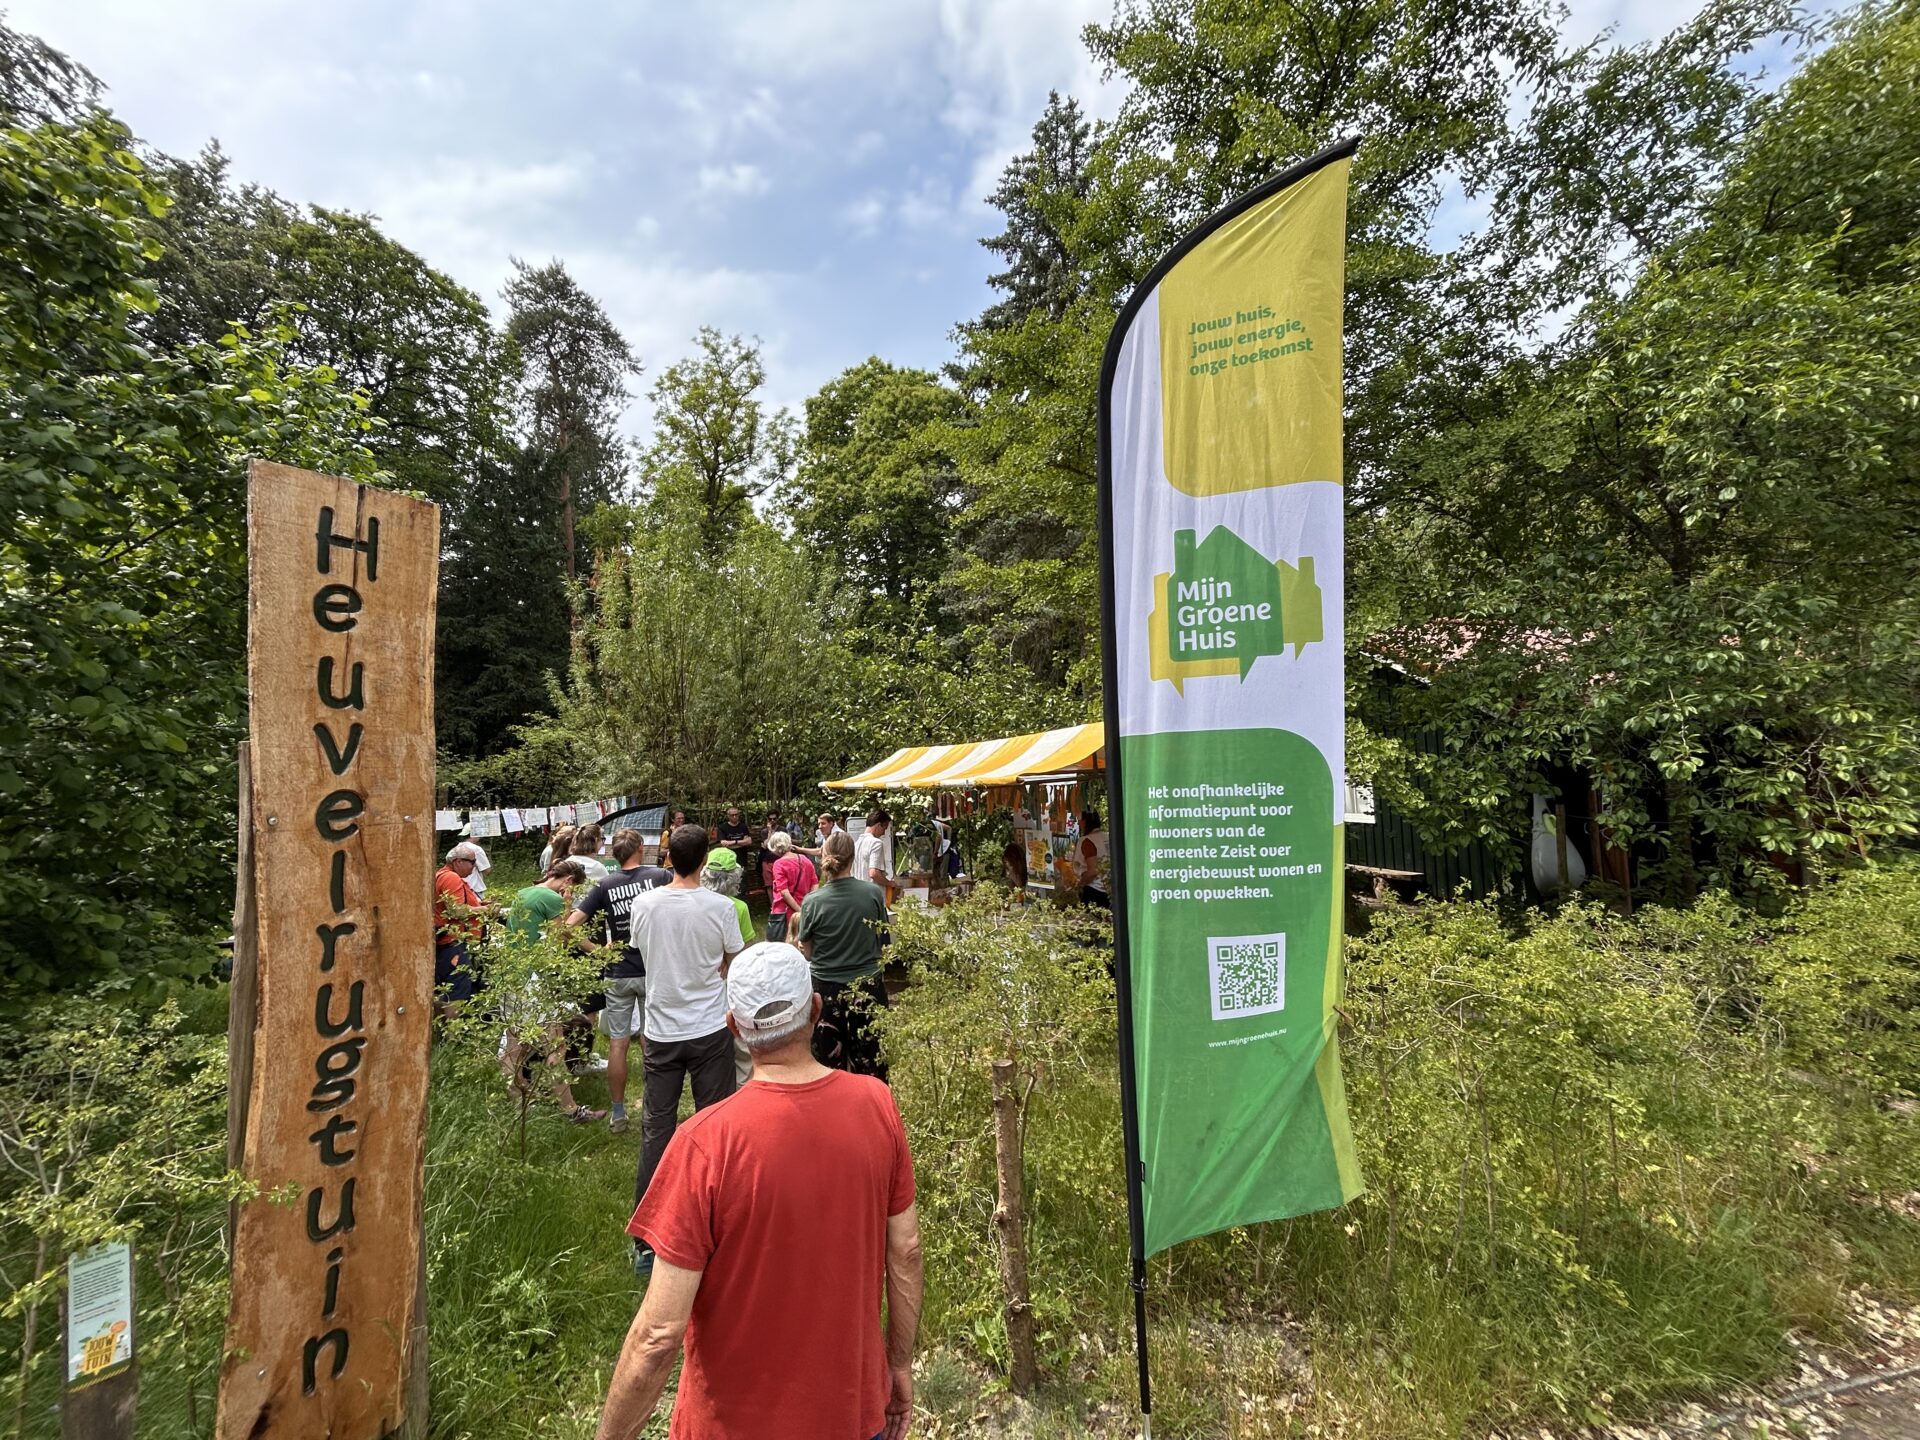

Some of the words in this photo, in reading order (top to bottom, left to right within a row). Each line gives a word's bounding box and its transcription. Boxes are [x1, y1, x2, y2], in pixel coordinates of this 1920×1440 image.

[1188, 316, 1233, 335] Jouw
[1236, 305, 1276, 324] huis,
[1191, 337, 1233, 358] jouw
[1237, 319, 1306, 345] energie,
[1189, 359, 1228, 376] onze
[1231, 338, 1314, 367] toekomst
[1177, 577, 1232, 606] Mijn
[1177, 602, 1272, 627] Groene
[1178, 625, 1237, 652] Huis
[1148, 785, 1169, 799] Het
[1172, 782, 1285, 801] onafhankelijke
[1148, 803, 1257, 822] informatiepunt
[1260, 804, 1294, 817] voor
[1149, 825, 1213, 839] inwoners
[1216, 826, 1244, 838] van
[1247, 824, 1266, 837] de
[1149, 845, 1218, 863] gemeente
[1220, 844, 1257, 859] Zeist
[1259, 845, 1292, 857] over
[1150, 865, 1256, 883] energiebewust
[1258, 864, 1304, 878] wonen
[1307, 863, 1322, 875] en
[1150, 888, 1190, 904] groen
[1193, 885, 1274, 903] opwekken.
[301, 505, 380, 1397] Heuvelrugtuin
[1207, 1028, 1288, 1048] www.mijngroenehuis.nu
